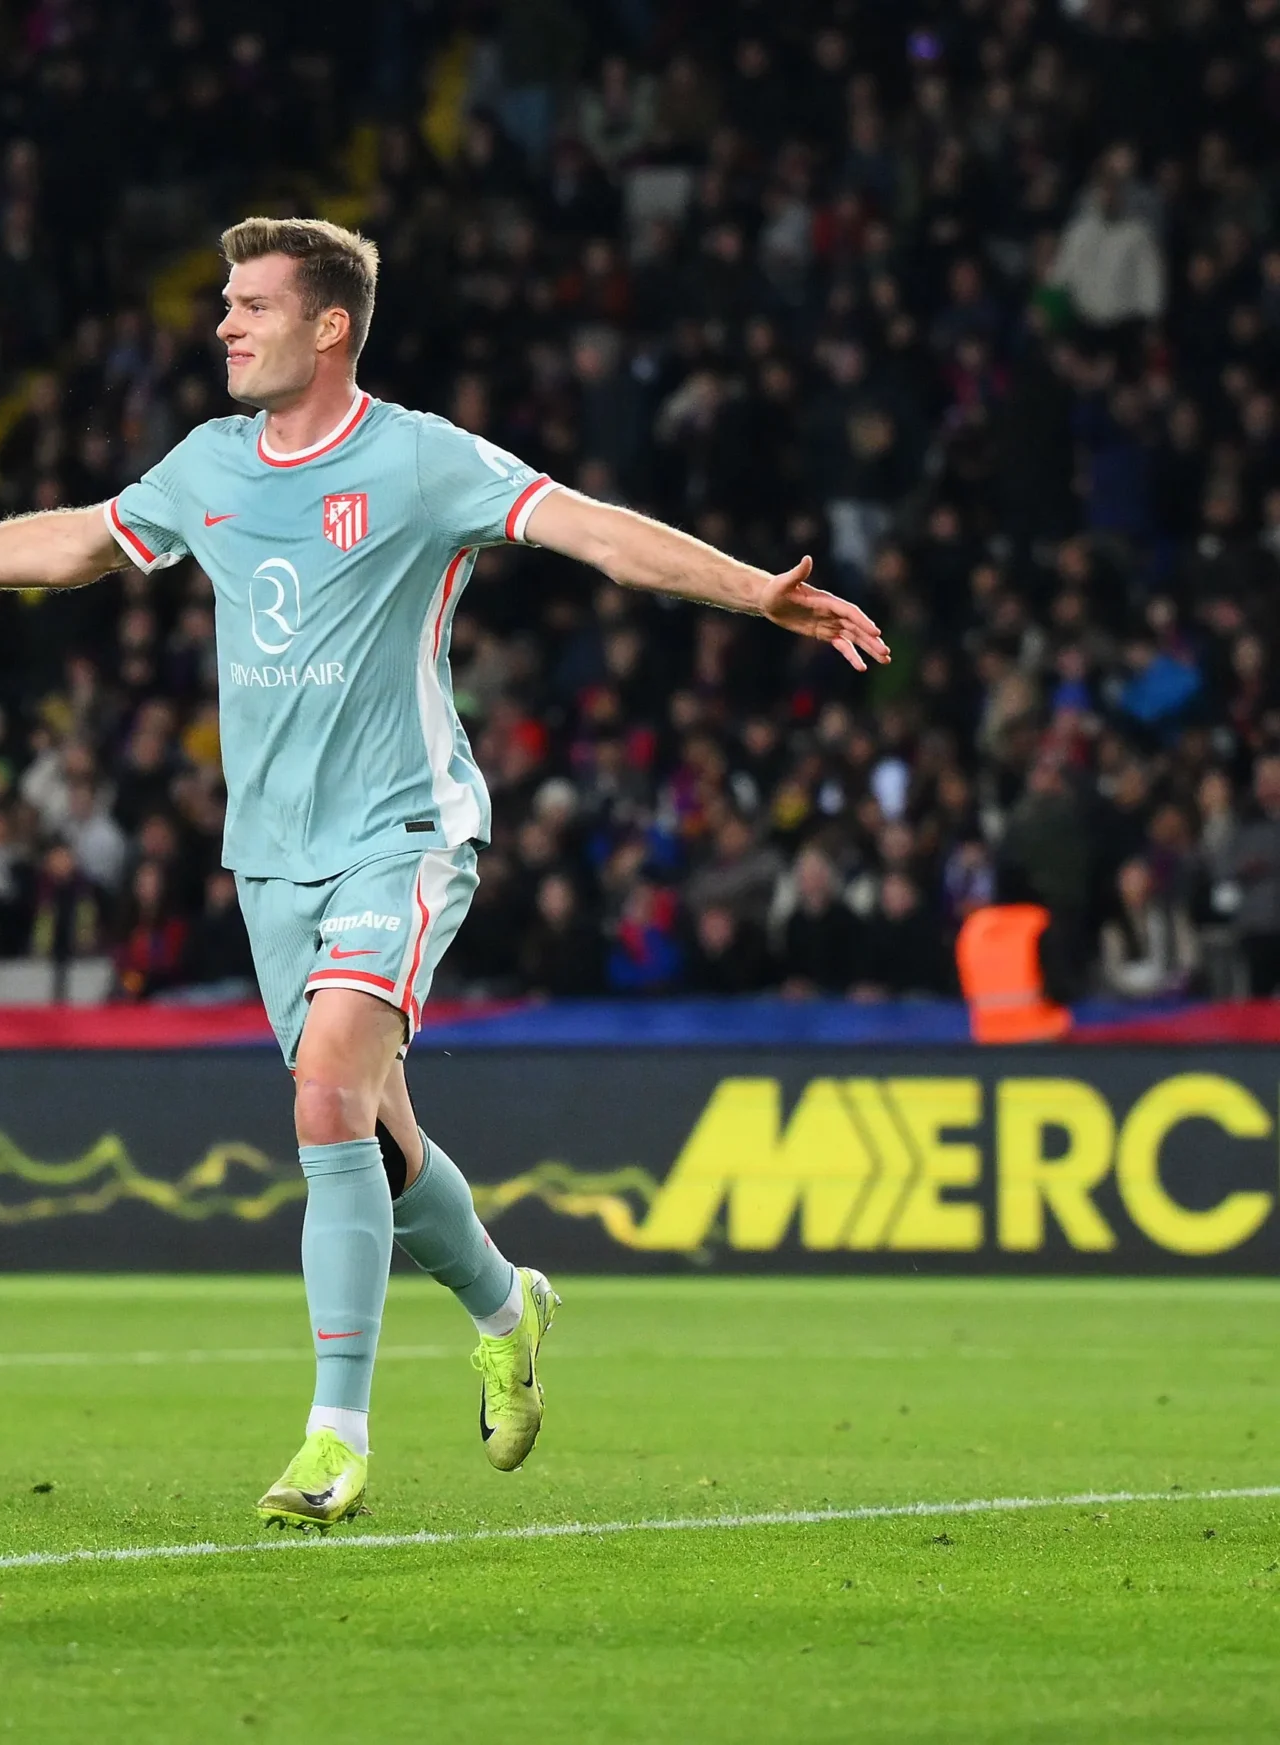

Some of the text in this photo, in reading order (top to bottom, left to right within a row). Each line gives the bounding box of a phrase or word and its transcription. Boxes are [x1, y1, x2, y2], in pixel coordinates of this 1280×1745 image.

[230, 661, 346, 688] RIYADH AIR
[320, 911, 401, 932] omAve
[636, 1071, 1280, 1256] MERC
